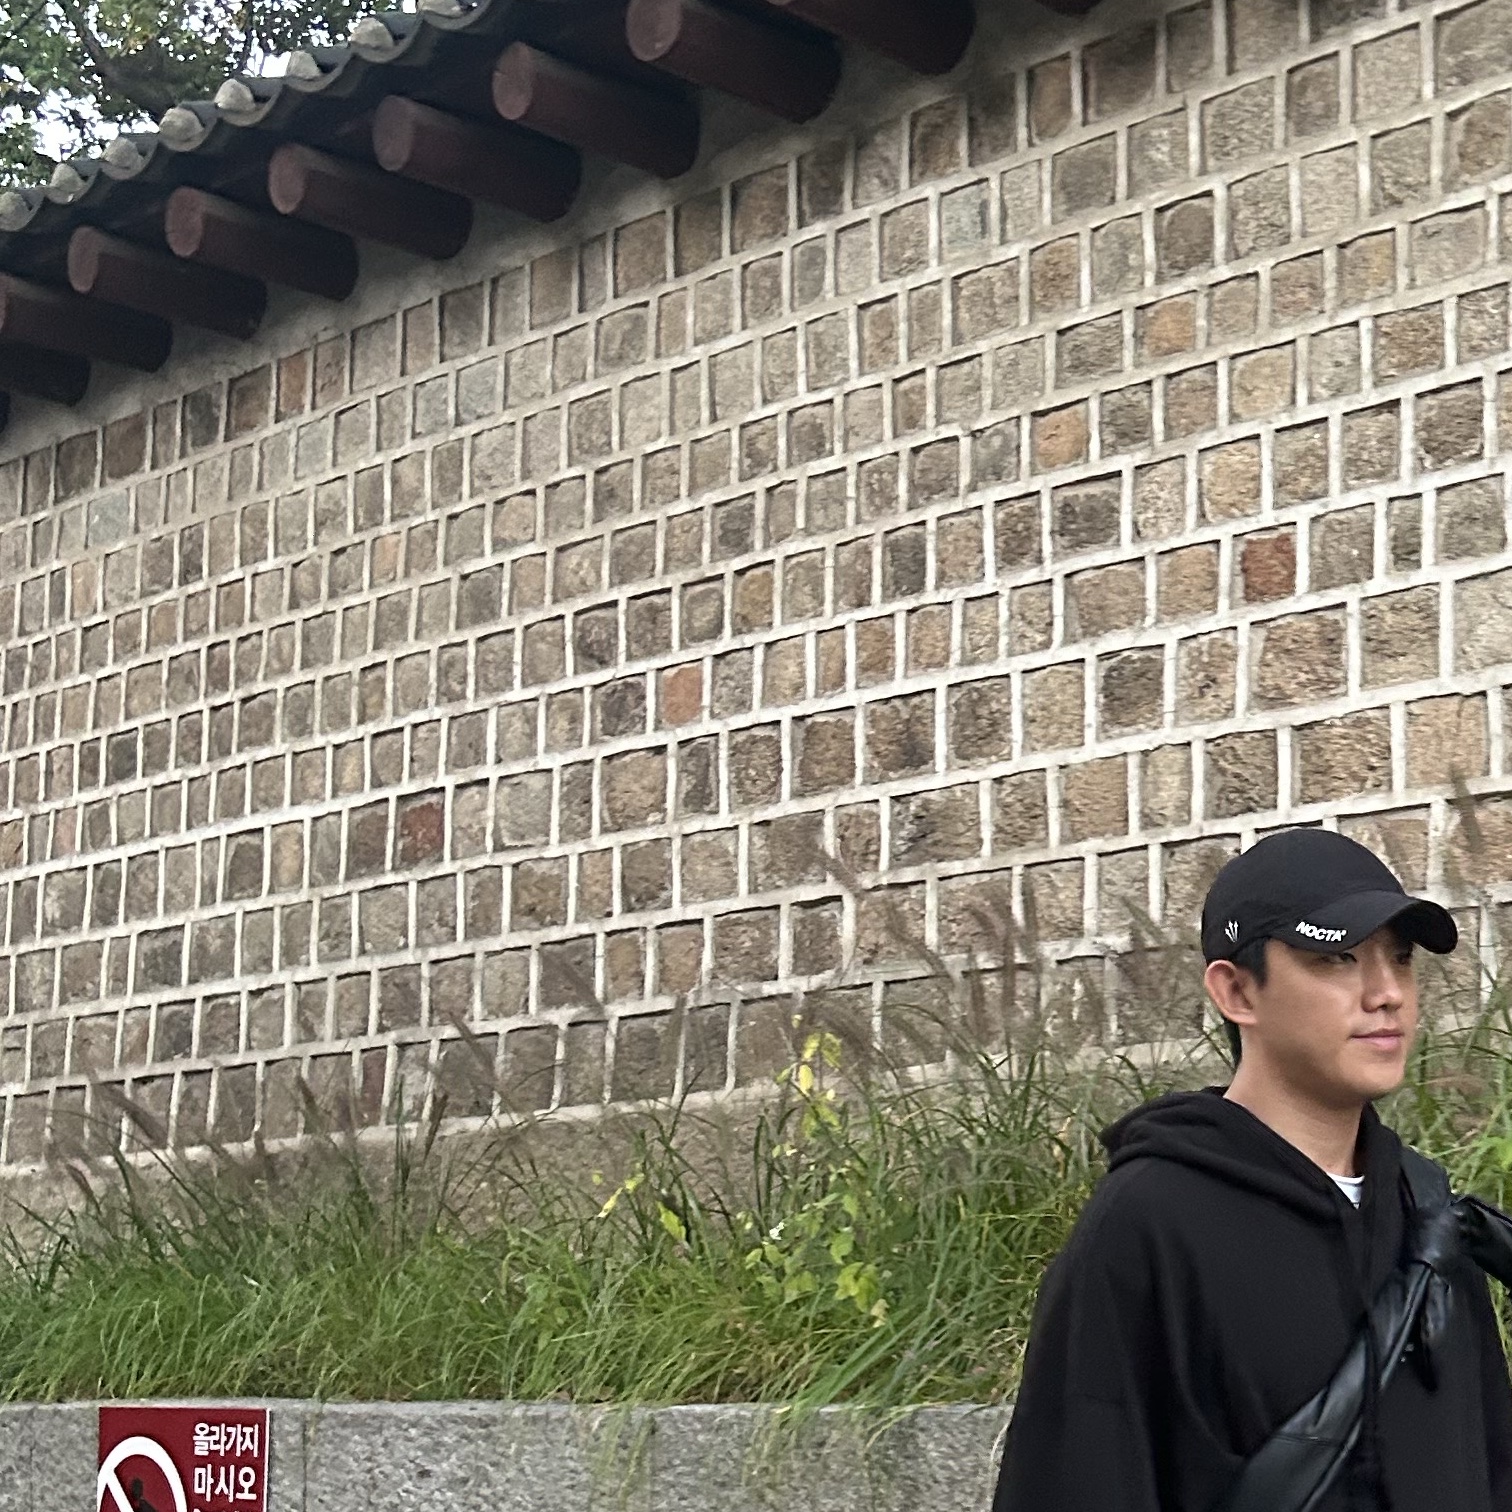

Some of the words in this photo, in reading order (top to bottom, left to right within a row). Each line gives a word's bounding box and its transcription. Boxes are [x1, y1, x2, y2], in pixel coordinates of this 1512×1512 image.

[1296, 921, 1345, 942] NOCTA
[192, 1422, 259, 1457] 올라가지
[193, 1464, 257, 1503] 마시오
